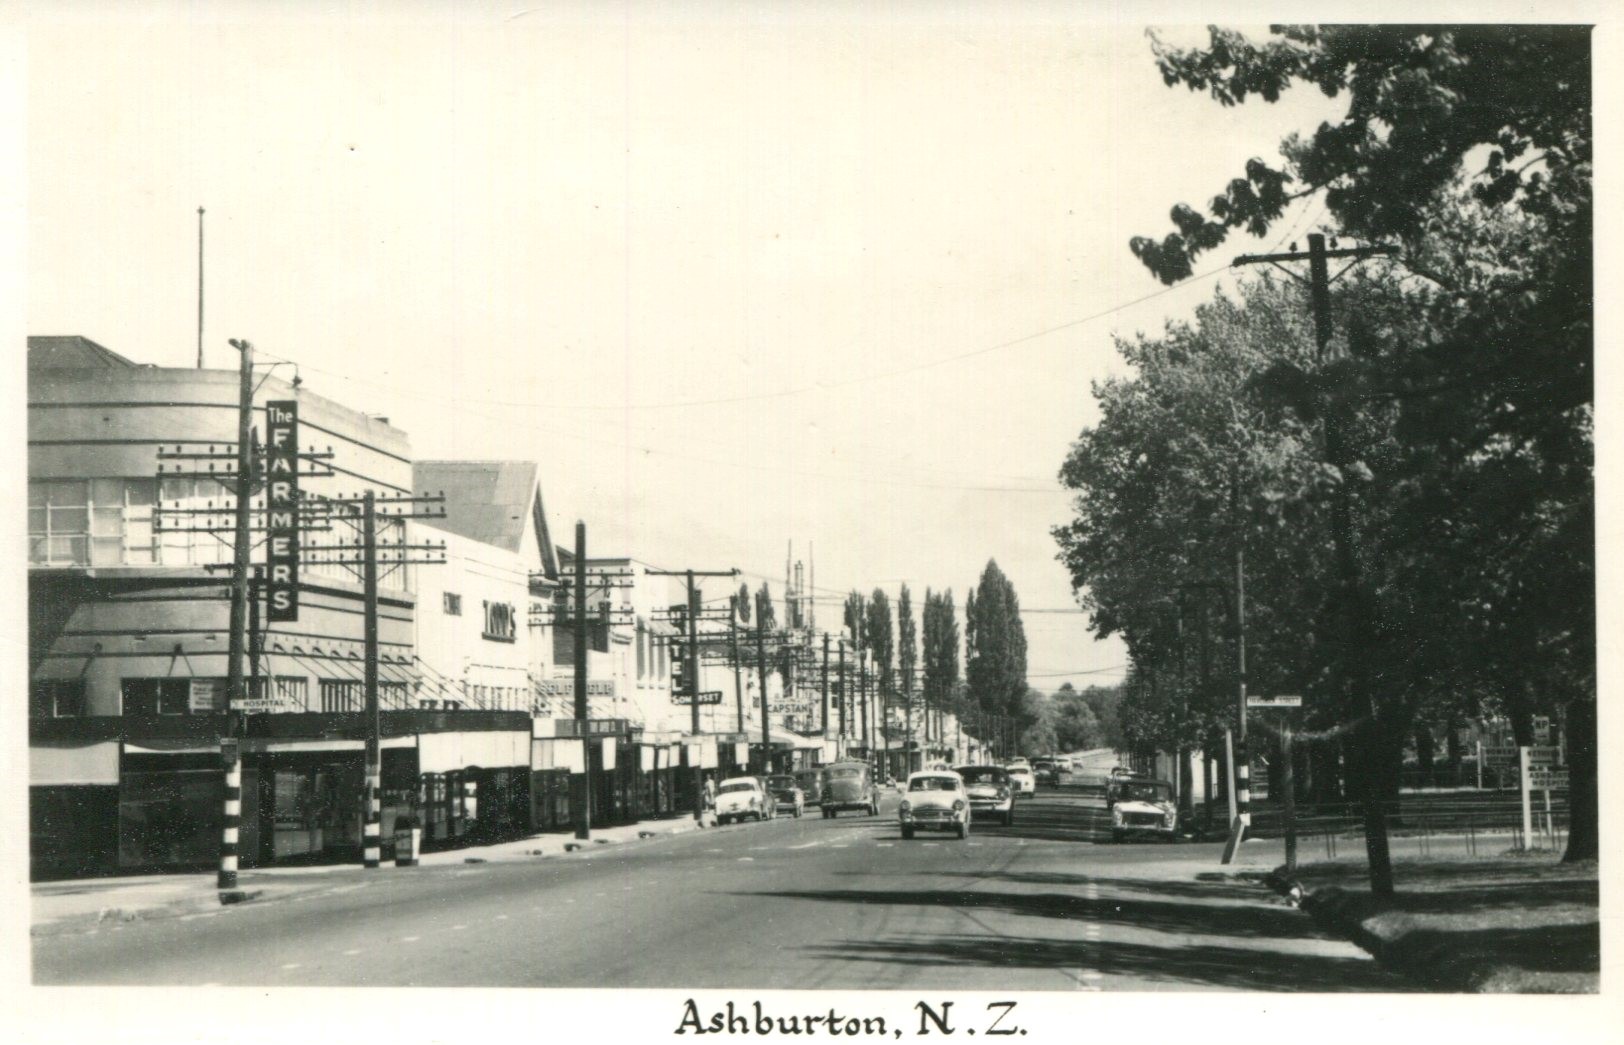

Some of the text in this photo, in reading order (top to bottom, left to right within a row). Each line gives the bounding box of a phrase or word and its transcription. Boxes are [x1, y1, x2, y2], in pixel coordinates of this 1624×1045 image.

[268, 407, 293, 424] The
[270, 427, 293, 611] FARMERS
[243, 699, 285, 707] HOSPITAL
[671, 693, 720, 705] SOMRSET
[767, 703, 808, 713] CAPSTAN
